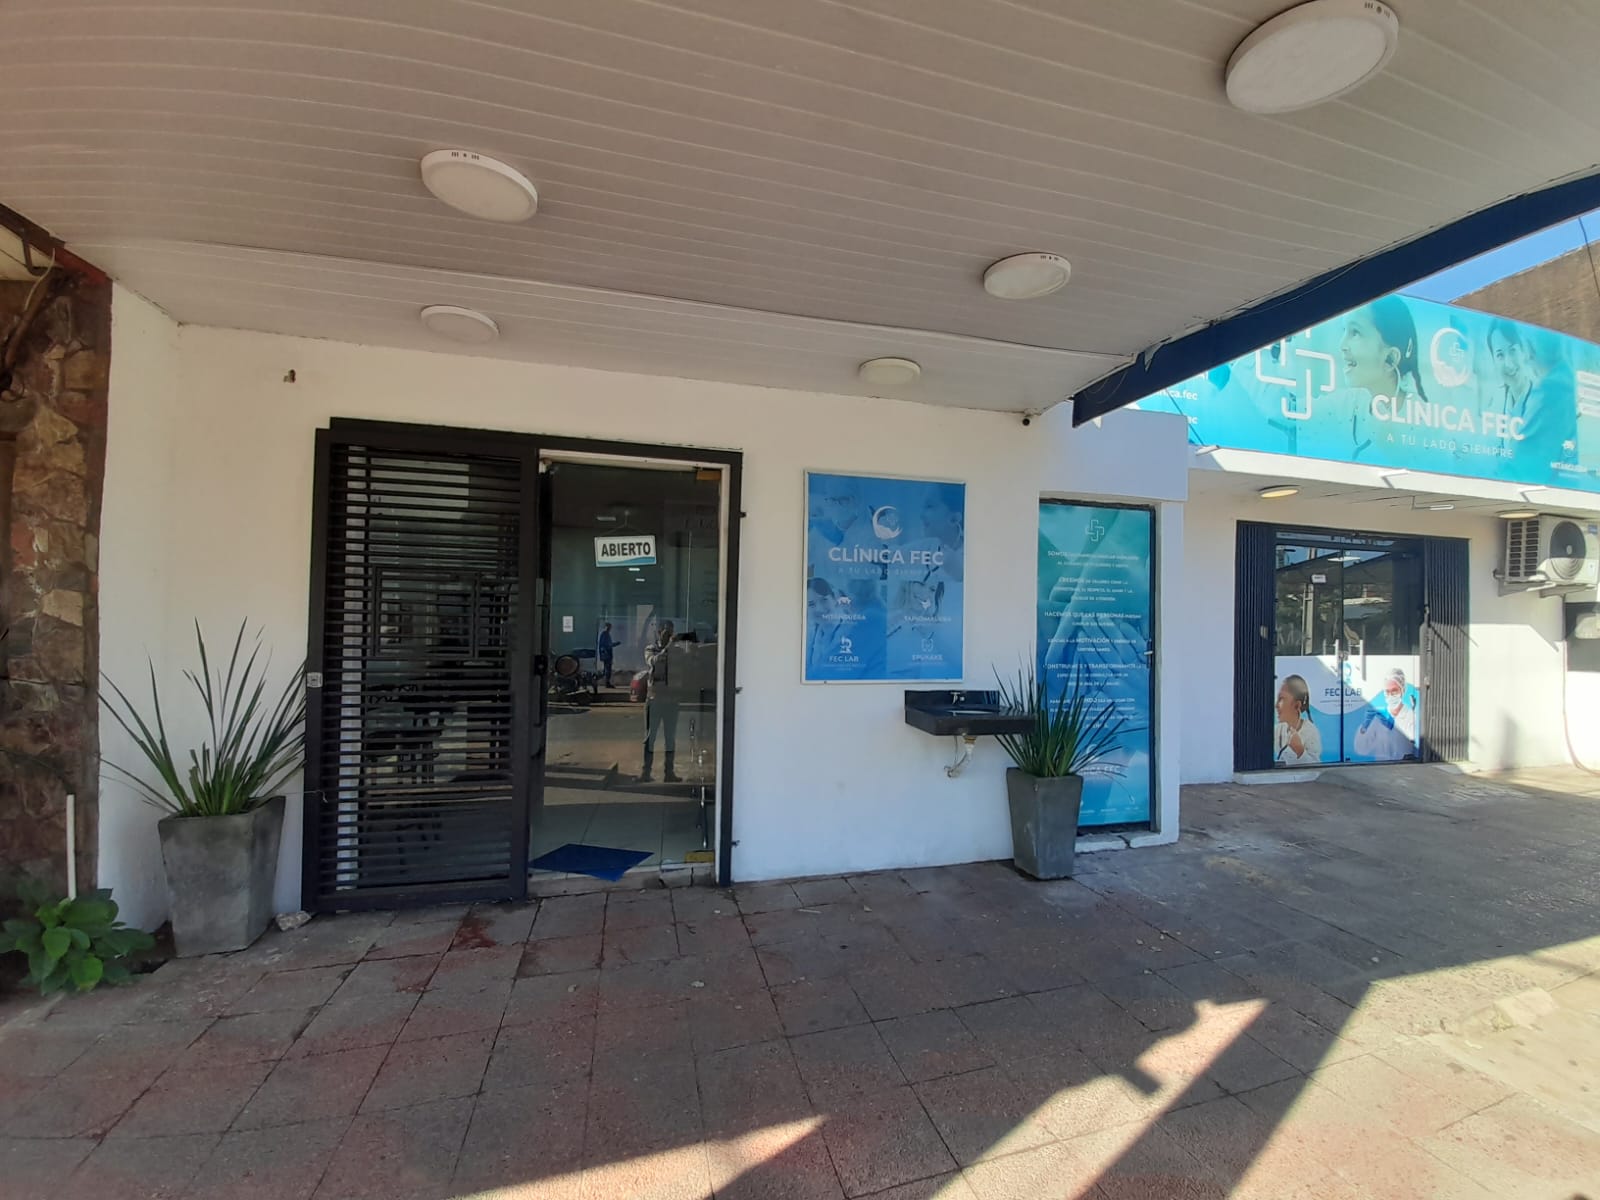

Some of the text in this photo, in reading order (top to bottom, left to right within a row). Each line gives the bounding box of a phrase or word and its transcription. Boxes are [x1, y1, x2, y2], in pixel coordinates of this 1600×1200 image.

[1372, 393, 1526, 441] CLÍNICA FEC
[1387, 433, 1514, 459] A TU LADO SIEMPRE
[601, 542, 651, 557] ABIERTO
[828, 544, 944, 566] CLÍNICA FEC
[829, 655, 859, 663] FEC LAB
[1325, 688, 1362, 697] FEC LAB
